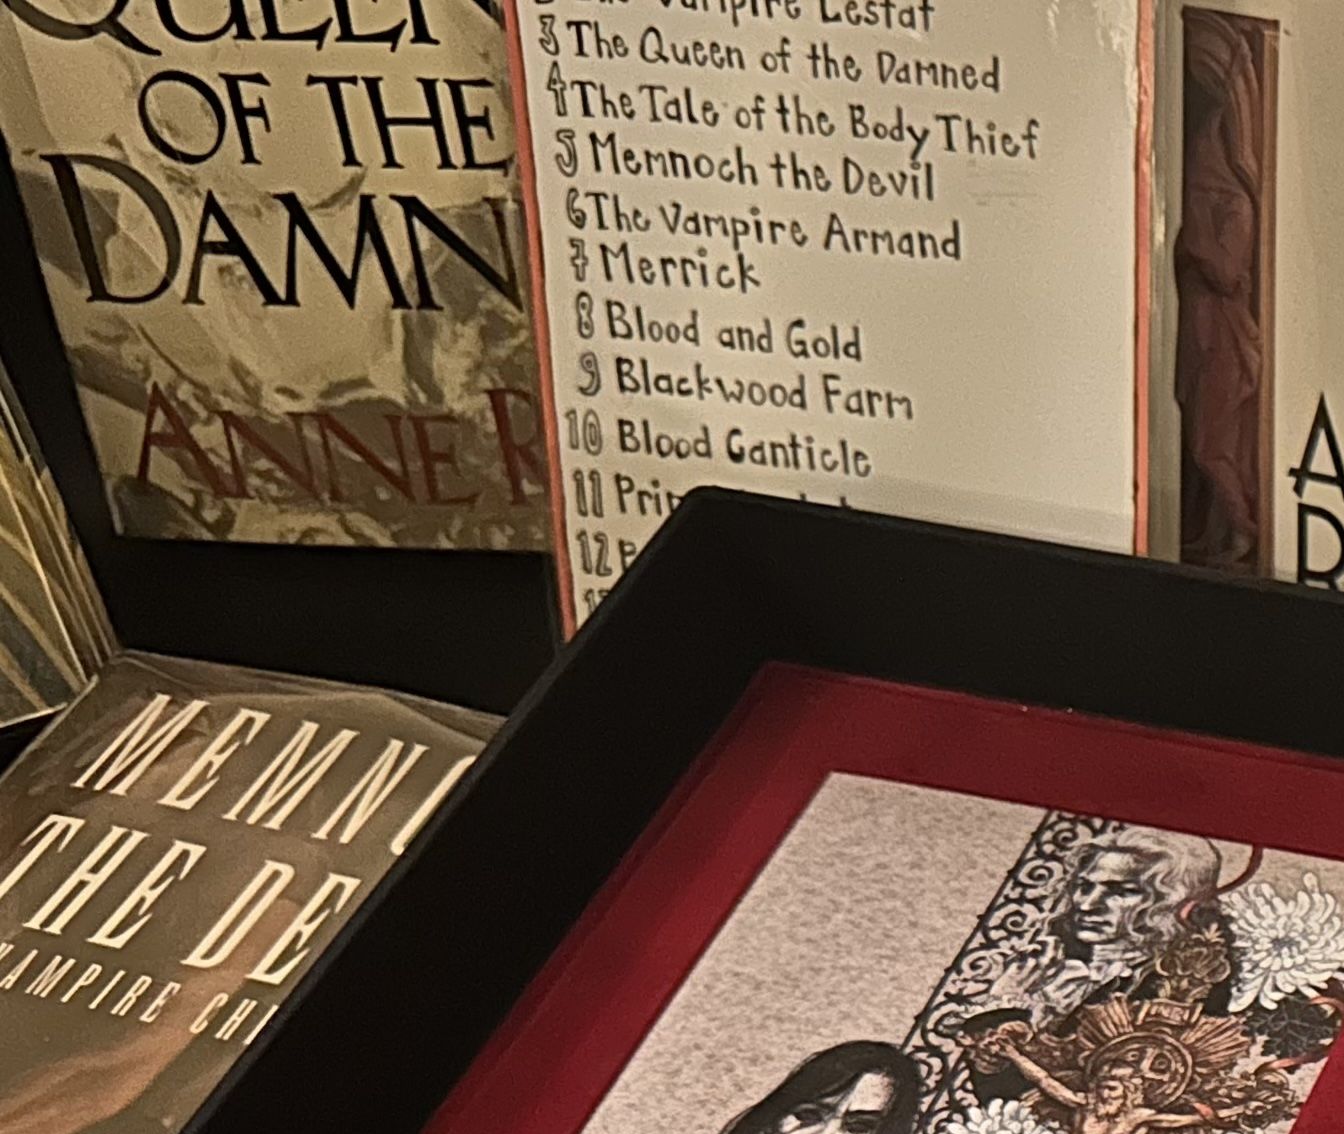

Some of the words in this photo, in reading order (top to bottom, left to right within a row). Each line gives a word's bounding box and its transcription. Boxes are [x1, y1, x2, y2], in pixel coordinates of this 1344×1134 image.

[538, 14, 560, 56] 3
[566, 20, 629, 60] The
[639, 26, 746, 70] Queen
[761, 36, 791, 75] of
[807, 43, 862, 83] the
[877, 51, 1000, 93] Damned
[138, 70, 272, 165] OF
[306, 73, 512, 177] THE
[547, 60, 567, 117] 4
[570, 79, 636, 119] The
[639, 84, 720, 127] Tale
[735, 95, 766, 131] of
[775, 93, 836, 138] the
[848, 103, 931, 162] Body
[934, 114, 1040, 160] Thief
[555, 129, 578, 178] 5
[589, 131, 758, 186] Memnoch
[769, 152, 832, 192] the
[843, 156, 935, 201] Devil
[40, 154, 526, 313] DAMN
[566, 187, 586, 230] 6
[585, 191, 651, 233] The
[659, 202, 808, 251] Vampire
[823, 212, 961, 260] Armand
[569, 238, 589, 282] 7
[599, 242, 762, 294] Merrick
[574, 290, 596, 340] 8
[606, 299, 701, 347] Blood
[718, 318, 774, 354] and
[785, 319, 863, 362] Gold
[577, 351, 601, 397] 9
[614, 356, 807, 411] Blackwood
[822, 373, 914, 421] Farm
[136, 381, 483, 503] ANNE
[564, 408, 603, 456] 10
[616, 417, 713, 460] Blood
[572, 468, 605, 518] 11
[575, 529, 613, 578] 12
[0, 813, 207, 949] THE
